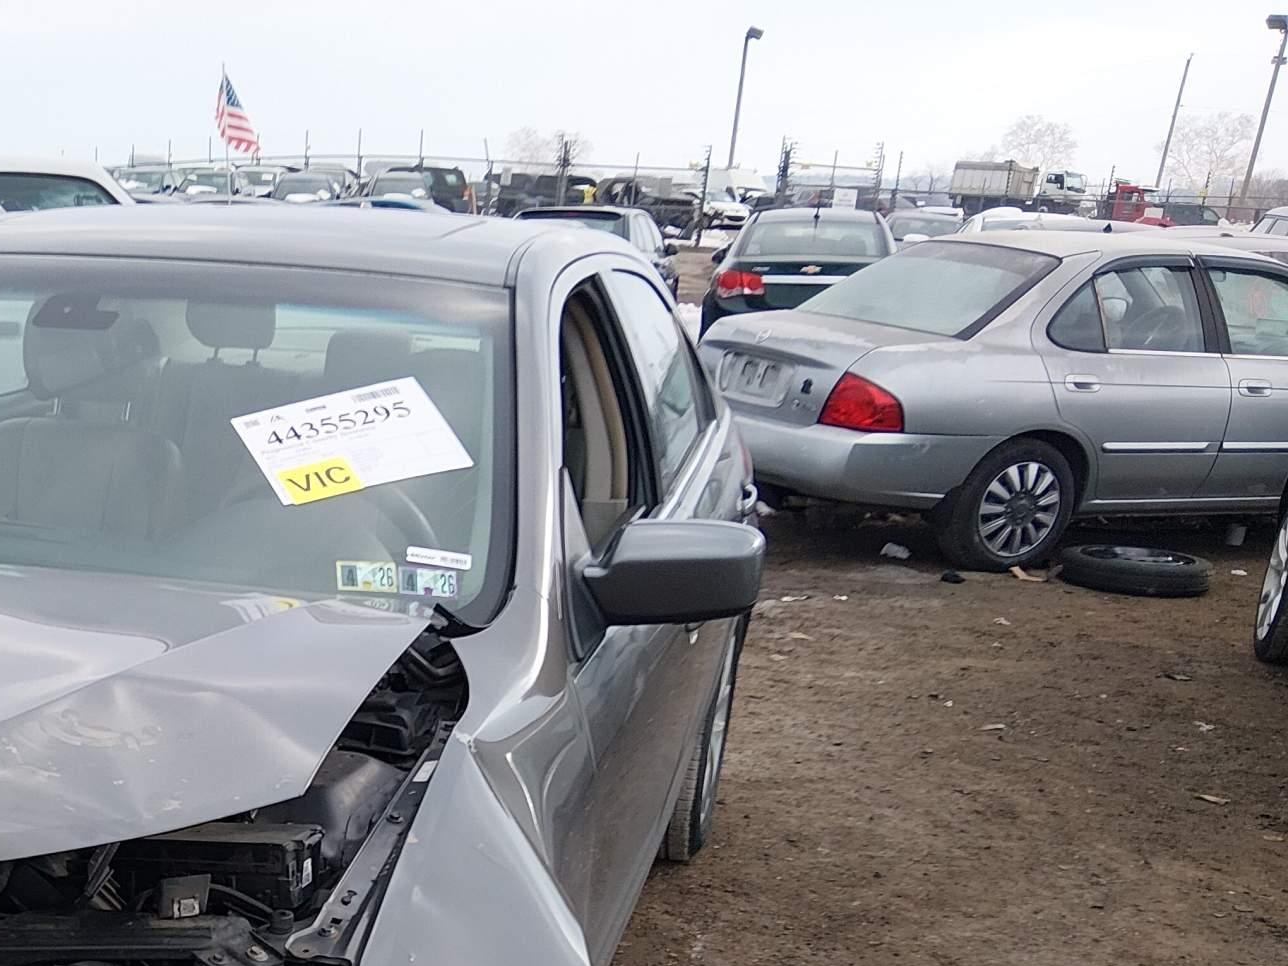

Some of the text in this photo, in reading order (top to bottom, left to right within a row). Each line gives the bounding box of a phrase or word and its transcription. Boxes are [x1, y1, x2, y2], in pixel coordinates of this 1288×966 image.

[267, 401, 411, 445] 44355295
[287, 466, 351, 493] VIC
[378, 567, 394, 588] 26
[439, 573, 455, 595] 26
